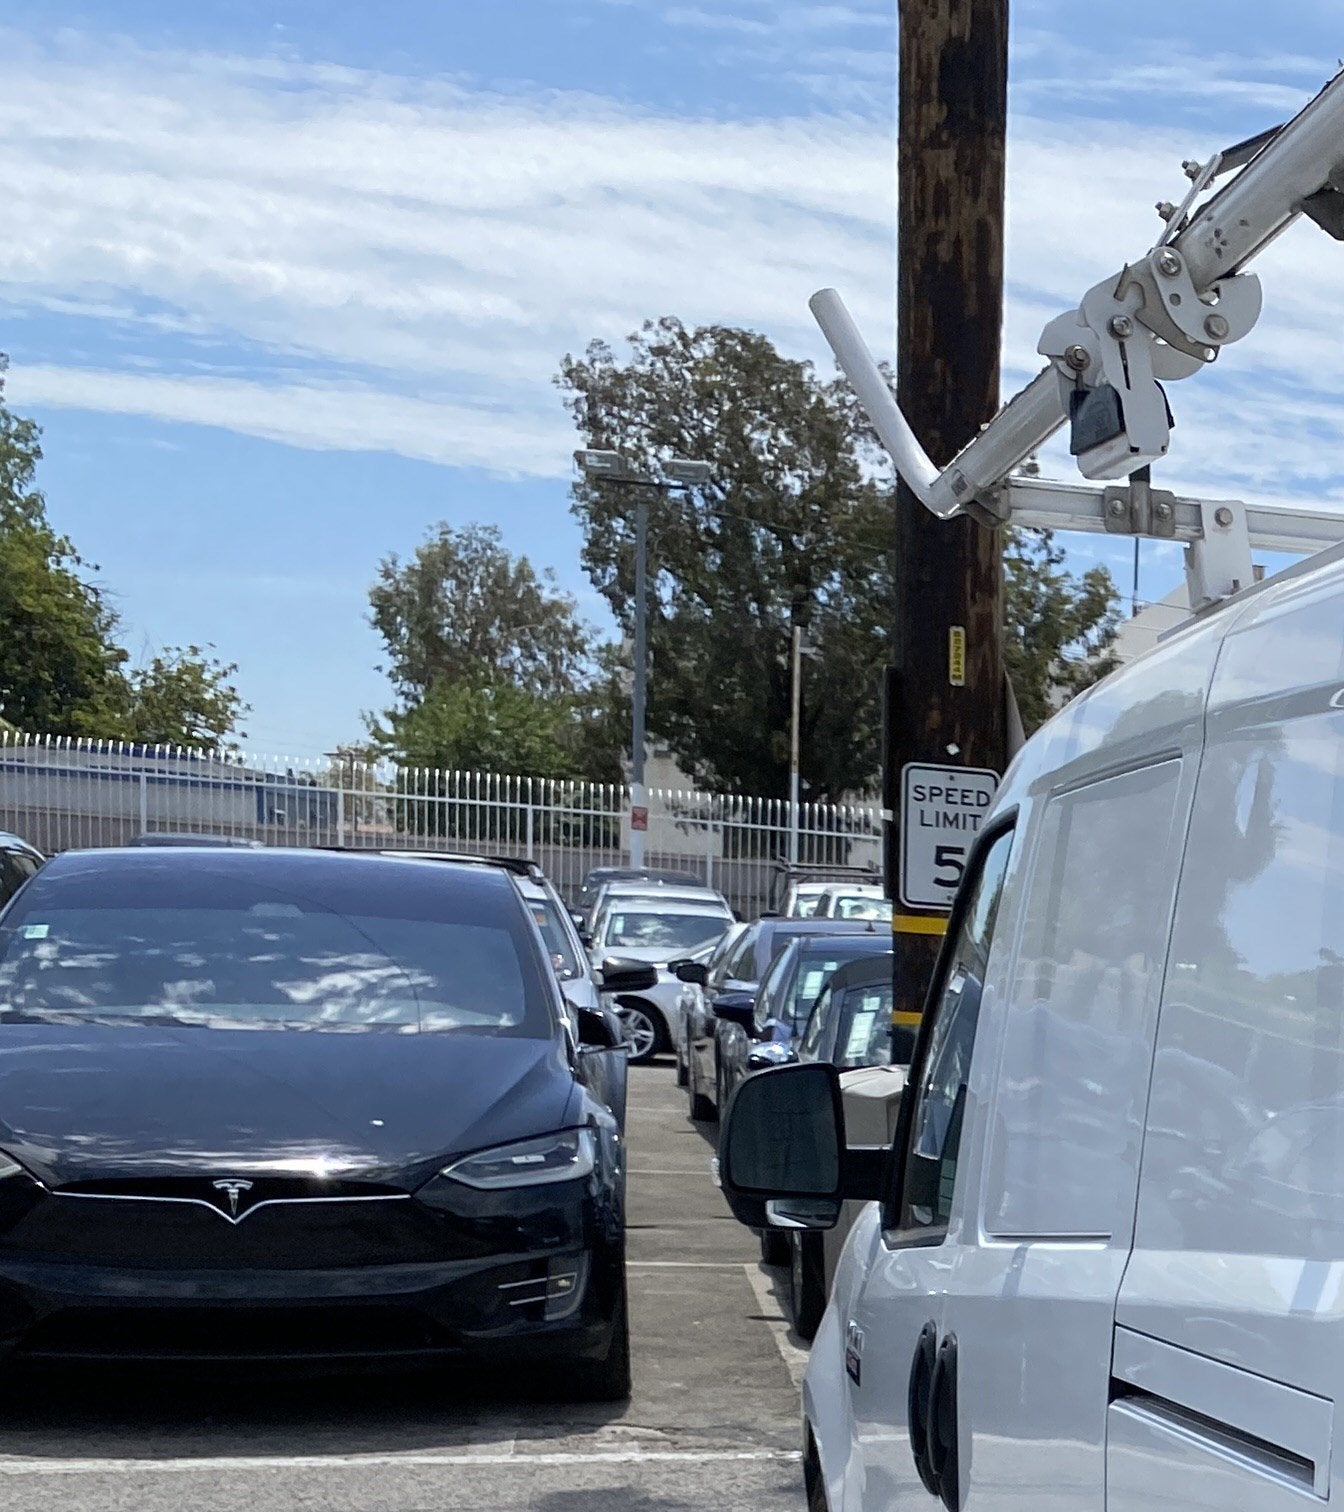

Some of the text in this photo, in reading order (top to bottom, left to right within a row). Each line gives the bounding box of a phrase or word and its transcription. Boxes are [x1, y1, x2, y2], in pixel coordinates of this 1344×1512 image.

[912, 784, 991, 807] SPEED
[920, 809, 982, 831] LIMIT
[933, 845, 966, 888] 5
